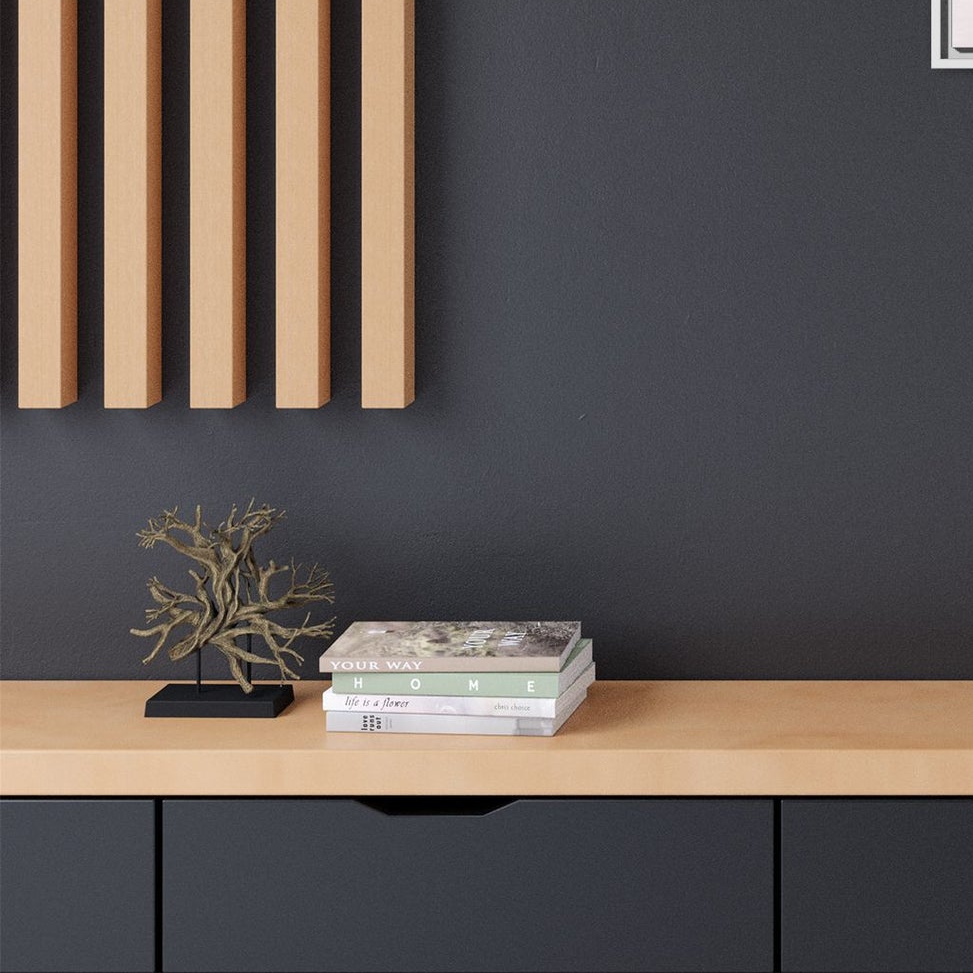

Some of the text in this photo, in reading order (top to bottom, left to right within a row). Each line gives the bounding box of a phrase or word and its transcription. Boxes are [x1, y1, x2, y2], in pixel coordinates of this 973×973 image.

[330, 661, 423, 670] YOUR WAY
[344, 696, 360, 710] life
[363, 697, 370, 706] is
[380, 697, 410, 711] flower
